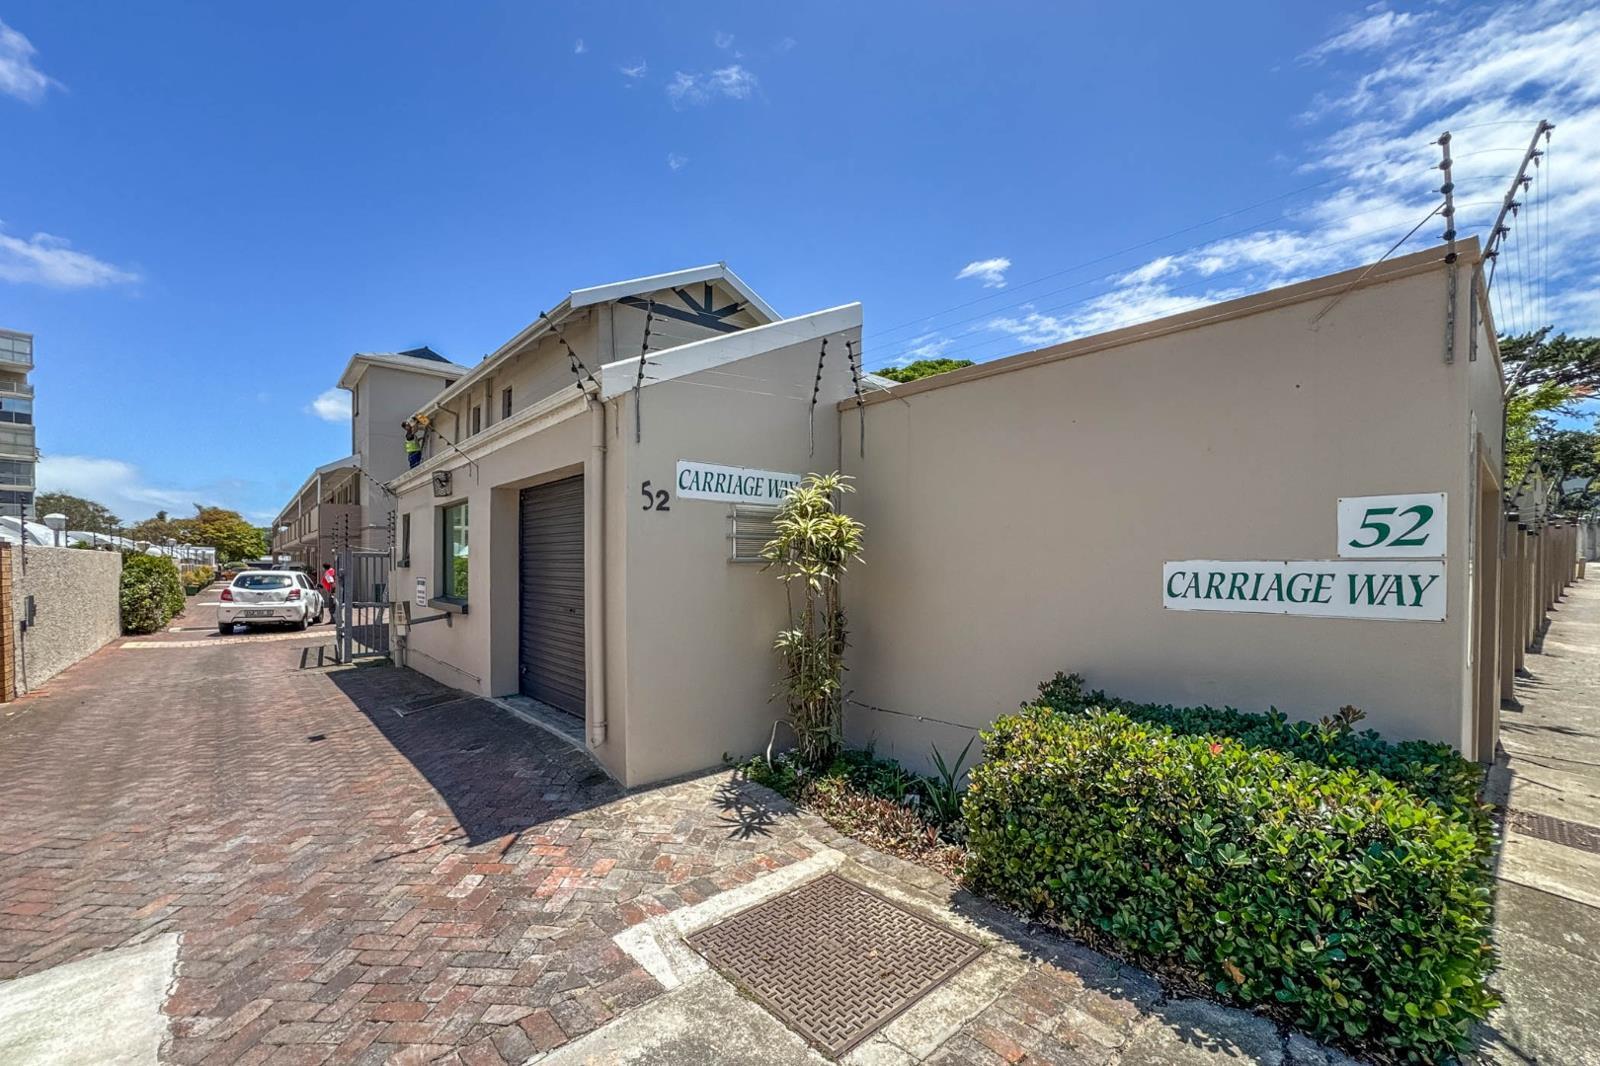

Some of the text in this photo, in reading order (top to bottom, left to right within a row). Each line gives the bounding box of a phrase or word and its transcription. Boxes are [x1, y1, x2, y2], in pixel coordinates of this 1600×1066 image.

[641, 479, 670, 511] 52
[678, 468, 764, 498] CARRIAGE
[1348, 504, 1434, 549] 52
[1166, 571, 1440, 607] CARRIAGE WAY
